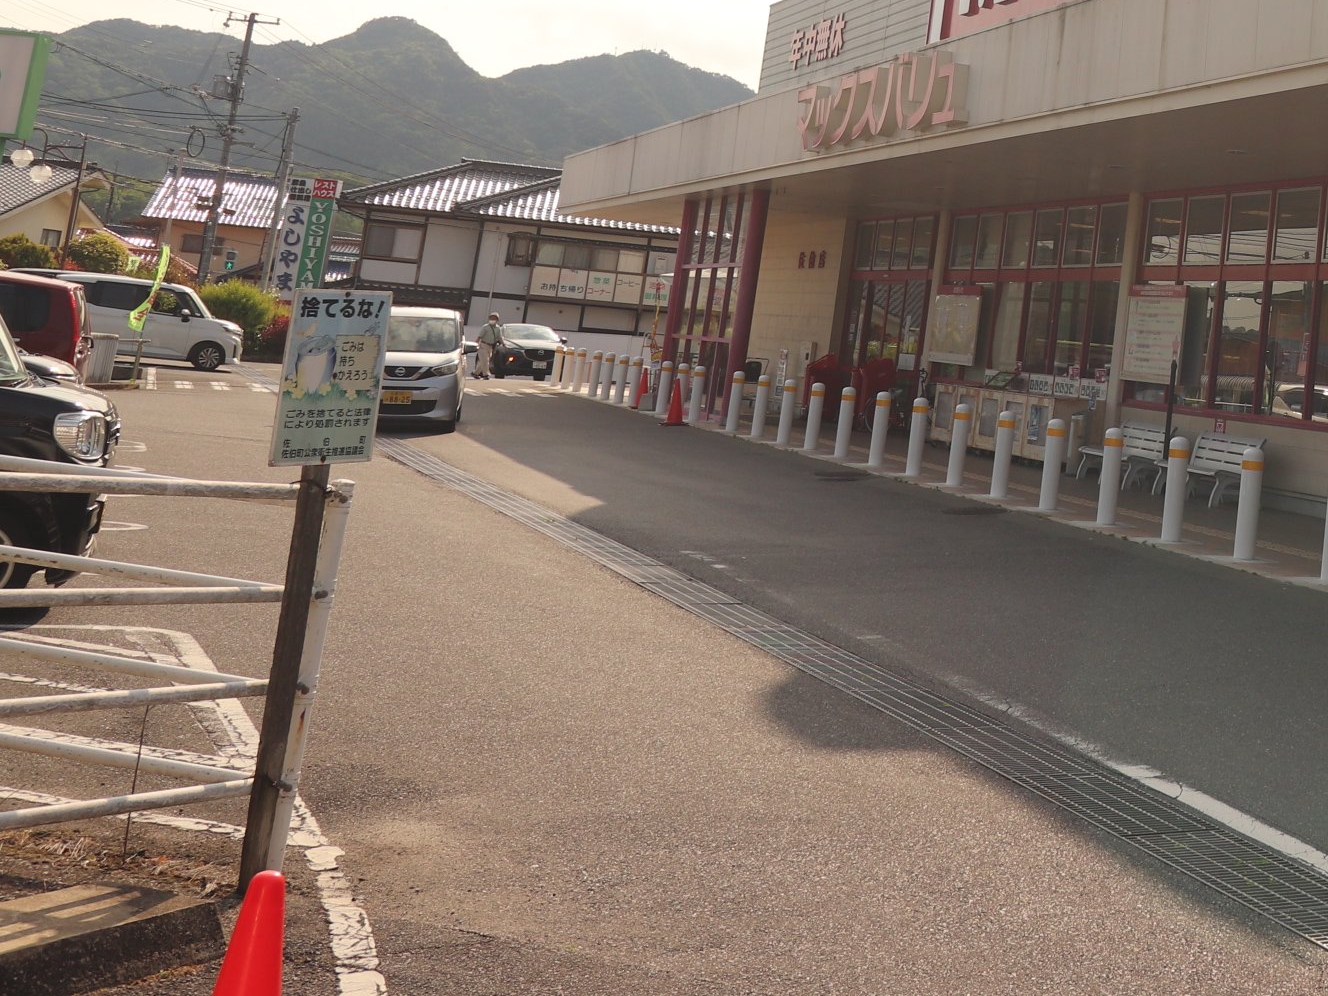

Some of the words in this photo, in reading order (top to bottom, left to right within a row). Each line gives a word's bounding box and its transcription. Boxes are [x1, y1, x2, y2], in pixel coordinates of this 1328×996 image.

[789, 12, 846, 70] 年中無休
[797, 51, 957, 150] マックスバリュ
[314, 181, 336, 189] レスト
[312, 189, 335, 198] ハウス
[277, 206, 305, 291] よしやま
[300, 202, 329, 289] YOSHIYAM
[540, 283, 585, 294] お持ち帰り
[617, 279, 640, 287] コーヒー
[587, 287, 611, 296] コーナー
[300, 296, 385, 319] 捨てるな!
[341, 341, 365, 352] ごみは
[338, 356, 355, 367] 持ち
[337, 370, 368, 381] かえろう
[285, 408, 371, 419] ごみを捨てると法律
